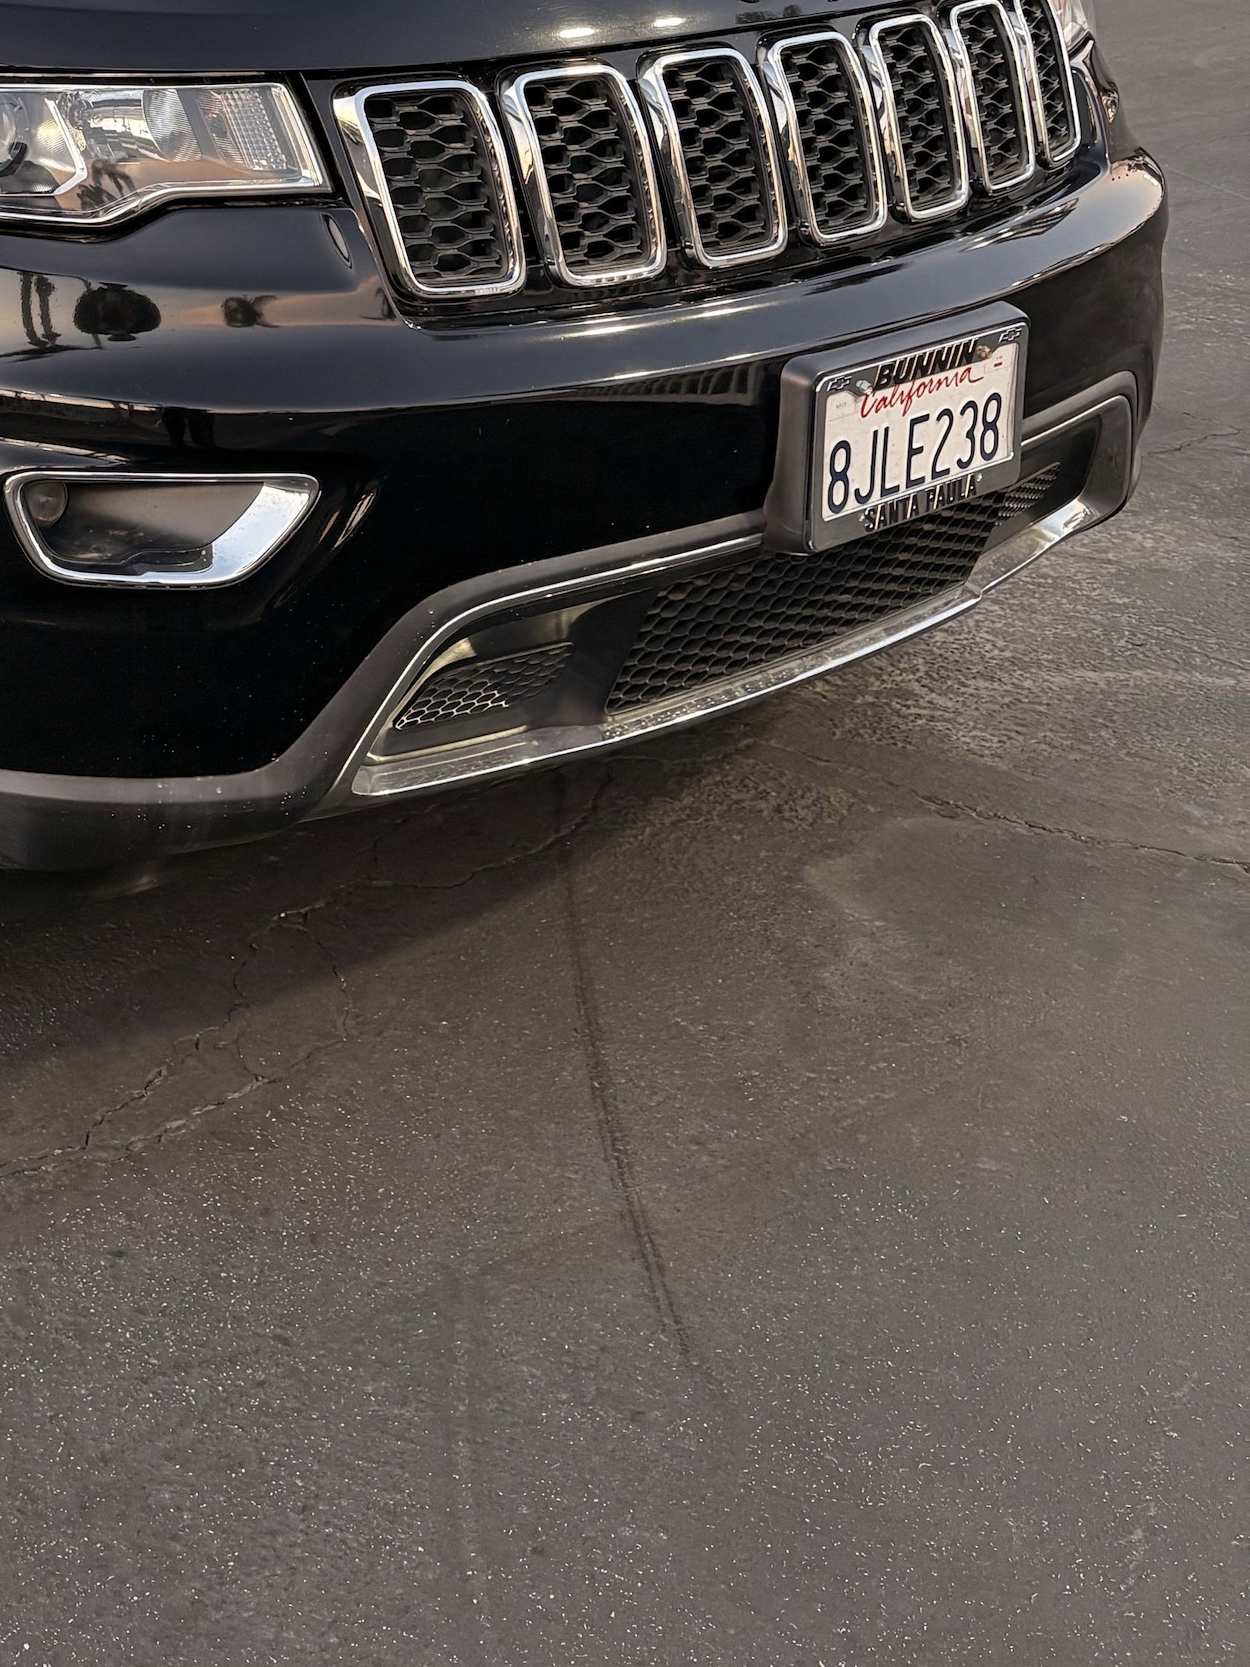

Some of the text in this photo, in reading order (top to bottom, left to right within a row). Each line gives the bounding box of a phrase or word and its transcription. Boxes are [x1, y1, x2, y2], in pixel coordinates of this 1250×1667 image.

[873, 338, 978, 388] BUNNIN
[859, 366, 983, 418] California
[826, 392, 1001, 514] 8JLE238
[864, 473, 977, 532] SANTA PAULA
